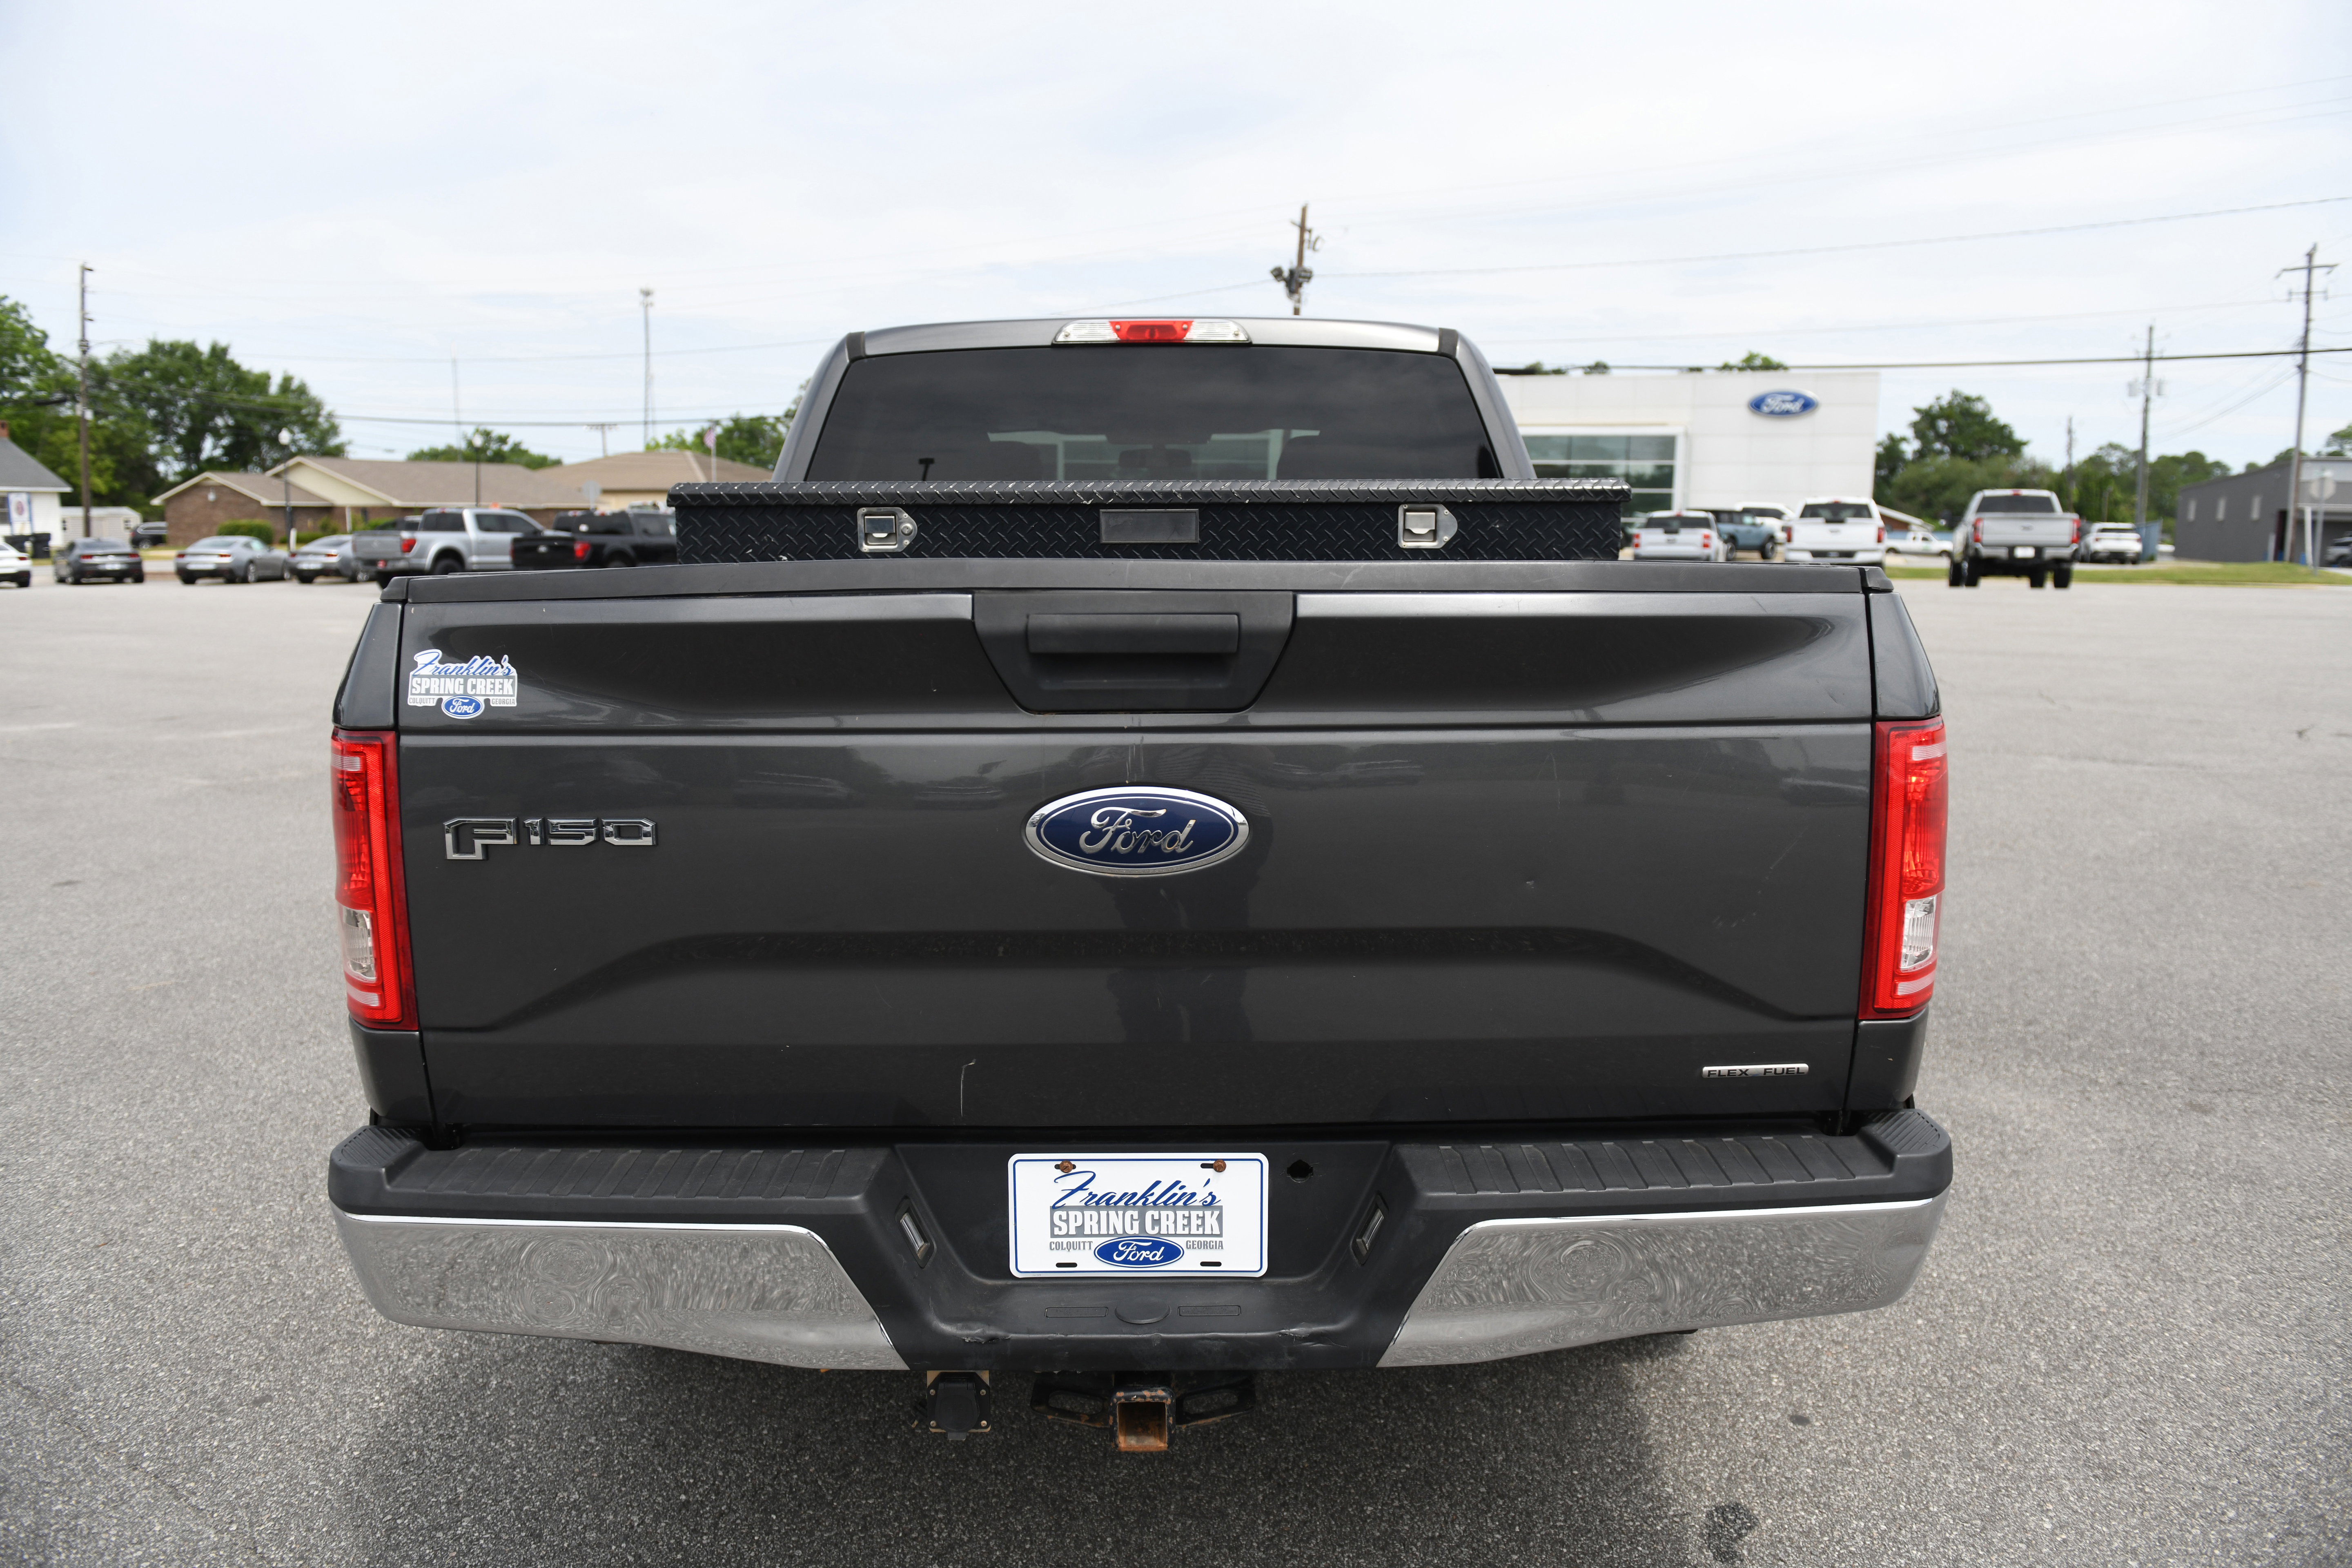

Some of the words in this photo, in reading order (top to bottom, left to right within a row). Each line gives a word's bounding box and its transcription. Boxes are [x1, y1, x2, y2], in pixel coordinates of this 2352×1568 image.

[1761, 393, 1804, 413] Ford
[412, 652, 514, 676] Franklin's
[412, 677, 464, 694] SPRING
[467, 678, 513, 694] CREEK
[450, 698, 474, 713] Ford
[1079, 806, 1197, 854] Ford
[1707, 1069, 1749, 1077] FLEX
[1763, 1067, 1805, 1075] FUEL
[1052, 1171, 1221, 1209] Franklin's
[1053, 1210, 1139, 1235] SPRING
[1145, 1210, 1220, 1235] CREEK
[1049, 1241, 1093, 1252] COLQUITT
[1113, 1241, 1165, 1261] Ford
[1186, 1240, 1224, 1250] GEORGIA
